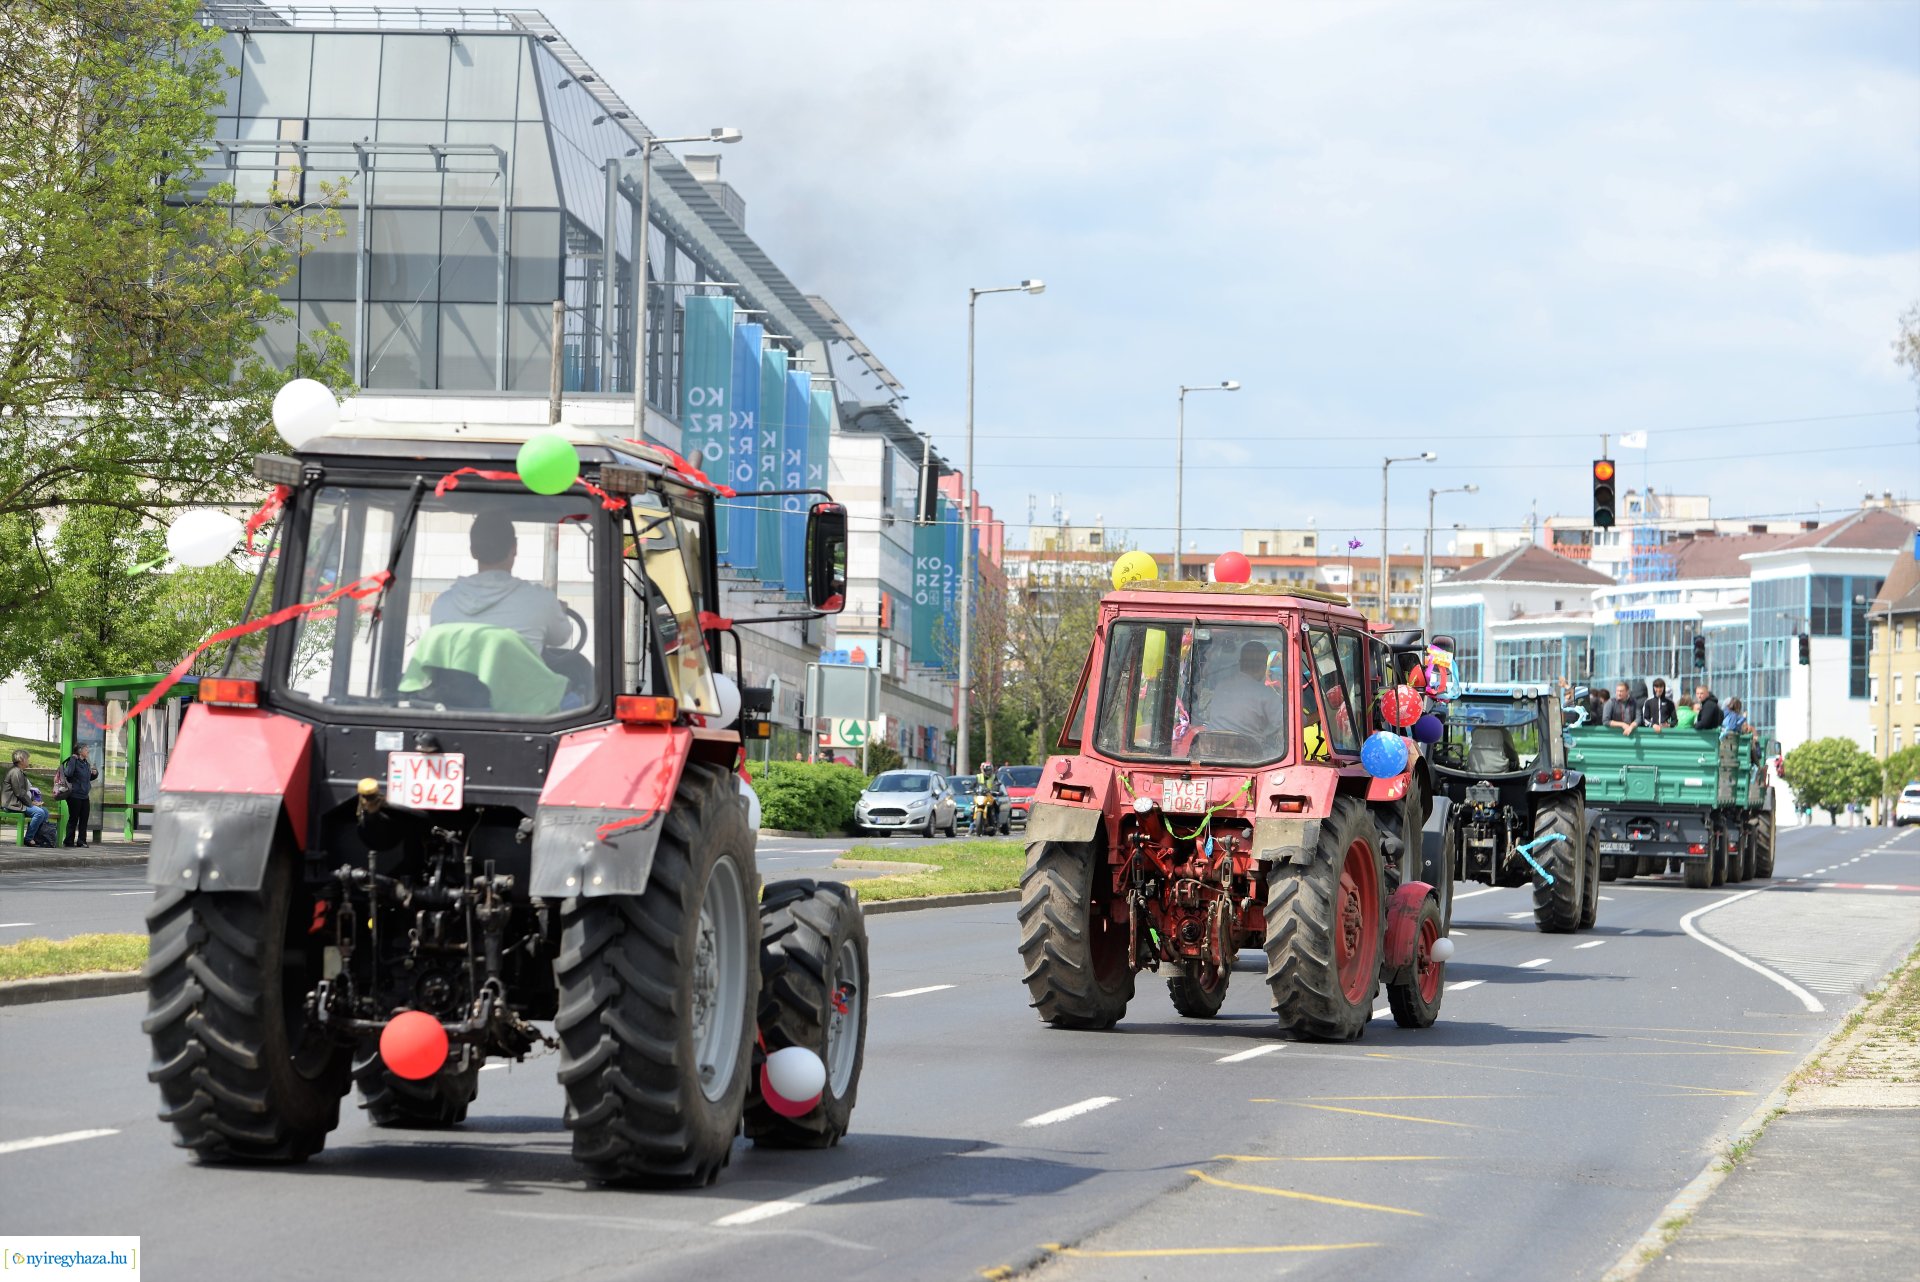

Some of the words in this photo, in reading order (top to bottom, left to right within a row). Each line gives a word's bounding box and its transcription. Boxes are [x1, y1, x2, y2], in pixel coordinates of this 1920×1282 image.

[916, 557, 941, 570] KO
[916, 574, 940, 587] RZ
[409, 759, 460, 781] YNG
[411, 783, 455, 805] 942
[1175, 797, 1202, 811] 064
